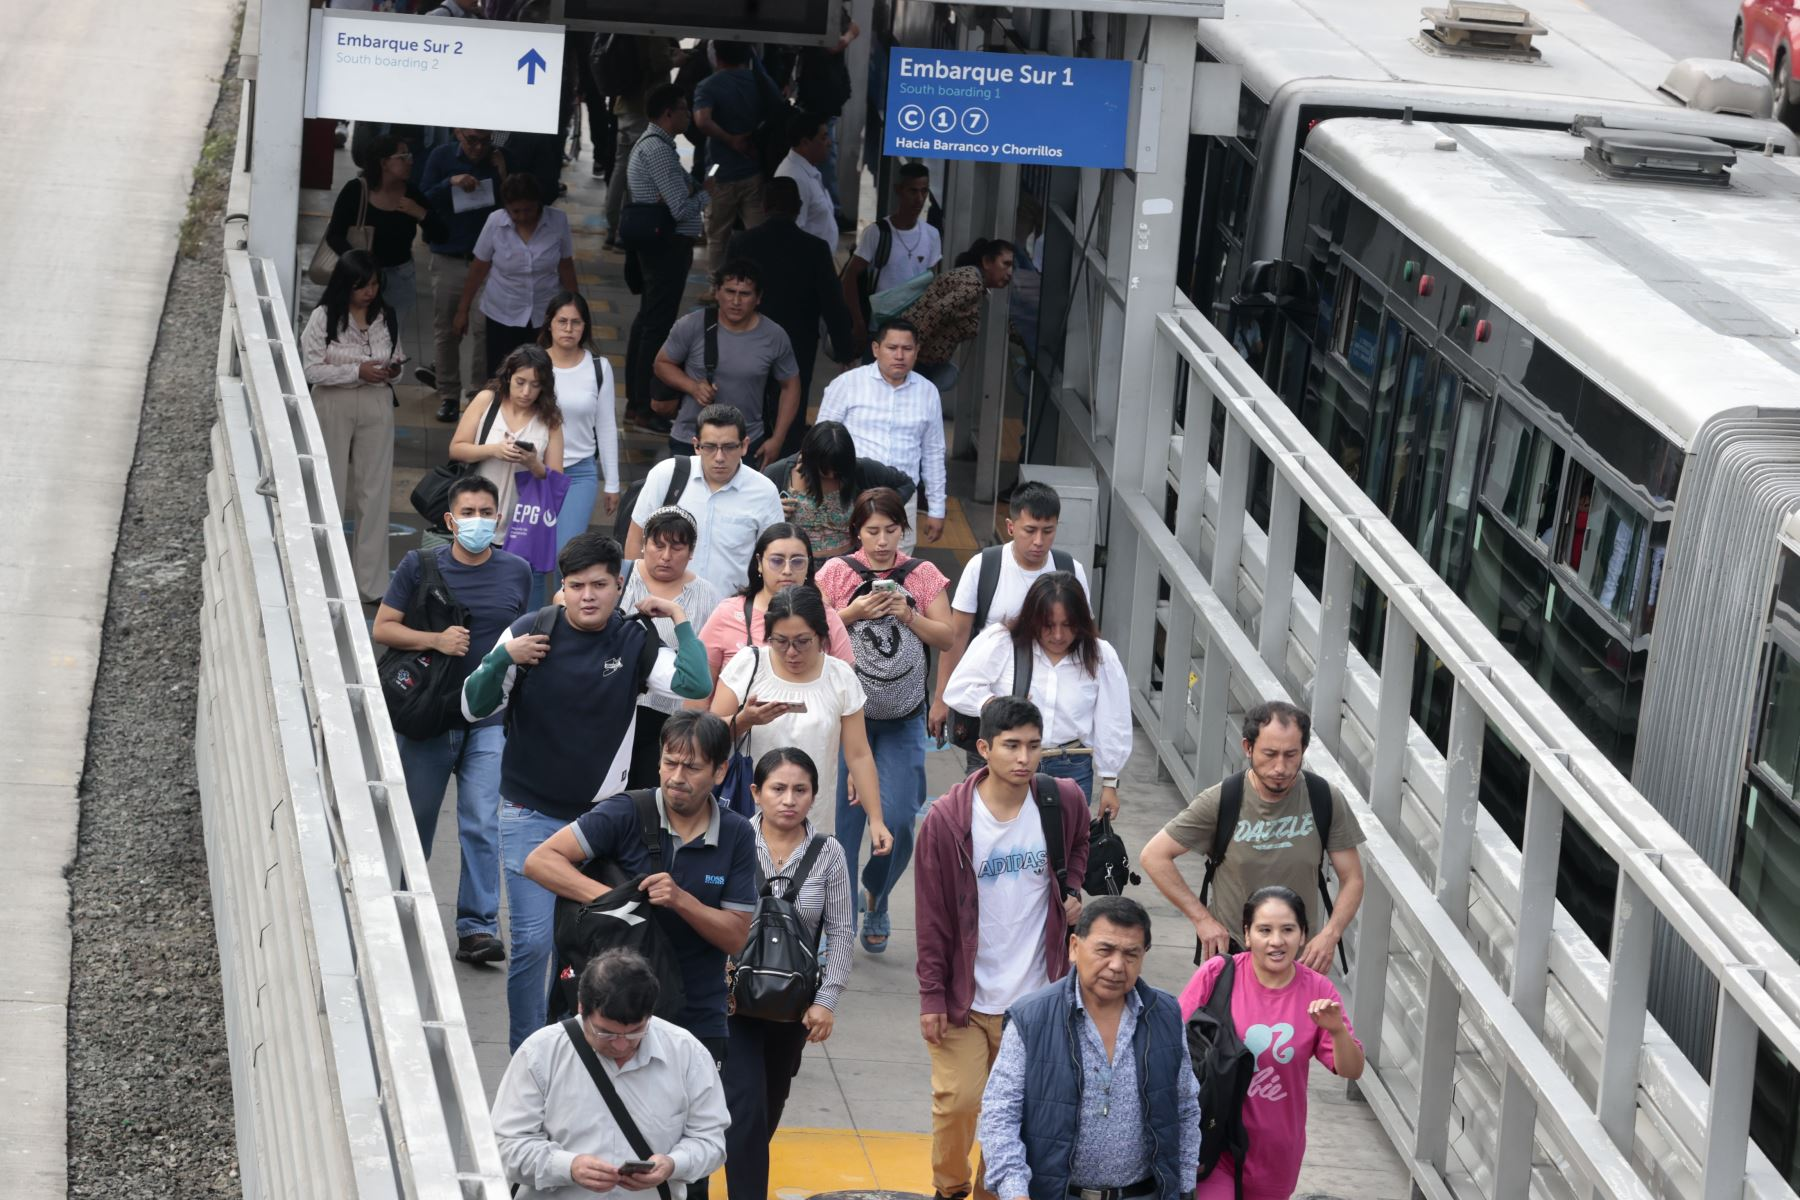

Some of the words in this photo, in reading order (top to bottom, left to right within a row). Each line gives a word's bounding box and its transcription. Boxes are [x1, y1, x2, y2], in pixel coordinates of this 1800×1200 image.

[337, 32, 419, 53] Embarque
[423, 39, 450, 53] Sur
[453, 41, 464, 54] 2
[336, 52, 370, 65] South
[374, 54, 429, 70] boarding
[431, 59, 439, 69] 2
[900, 58, 1014, 86] Embarque
[1019, 65, 1056, 85] Sur
[1062, 68, 1074, 86] 1
[899, 83, 935, 96] South
[938, 86, 991, 100] boarding
[994, 88, 1001, 98] 1
[904, 110, 918, 125] C
[937, 112, 949, 127] 1
[969, 113, 981, 128] 7
[896, 137, 930, 149] Hacia
[933, 140, 989, 153] Barranco
[991, 146, 999, 155] y
[1001, 144, 1063, 157] Chorrillos
[512, 504, 540, 524] EPG
[1233, 813, 1314, 842] DAZZLE
[978, 851, 1048, 878] ADIDAS
[705, 874, 725, 882] BOSS
